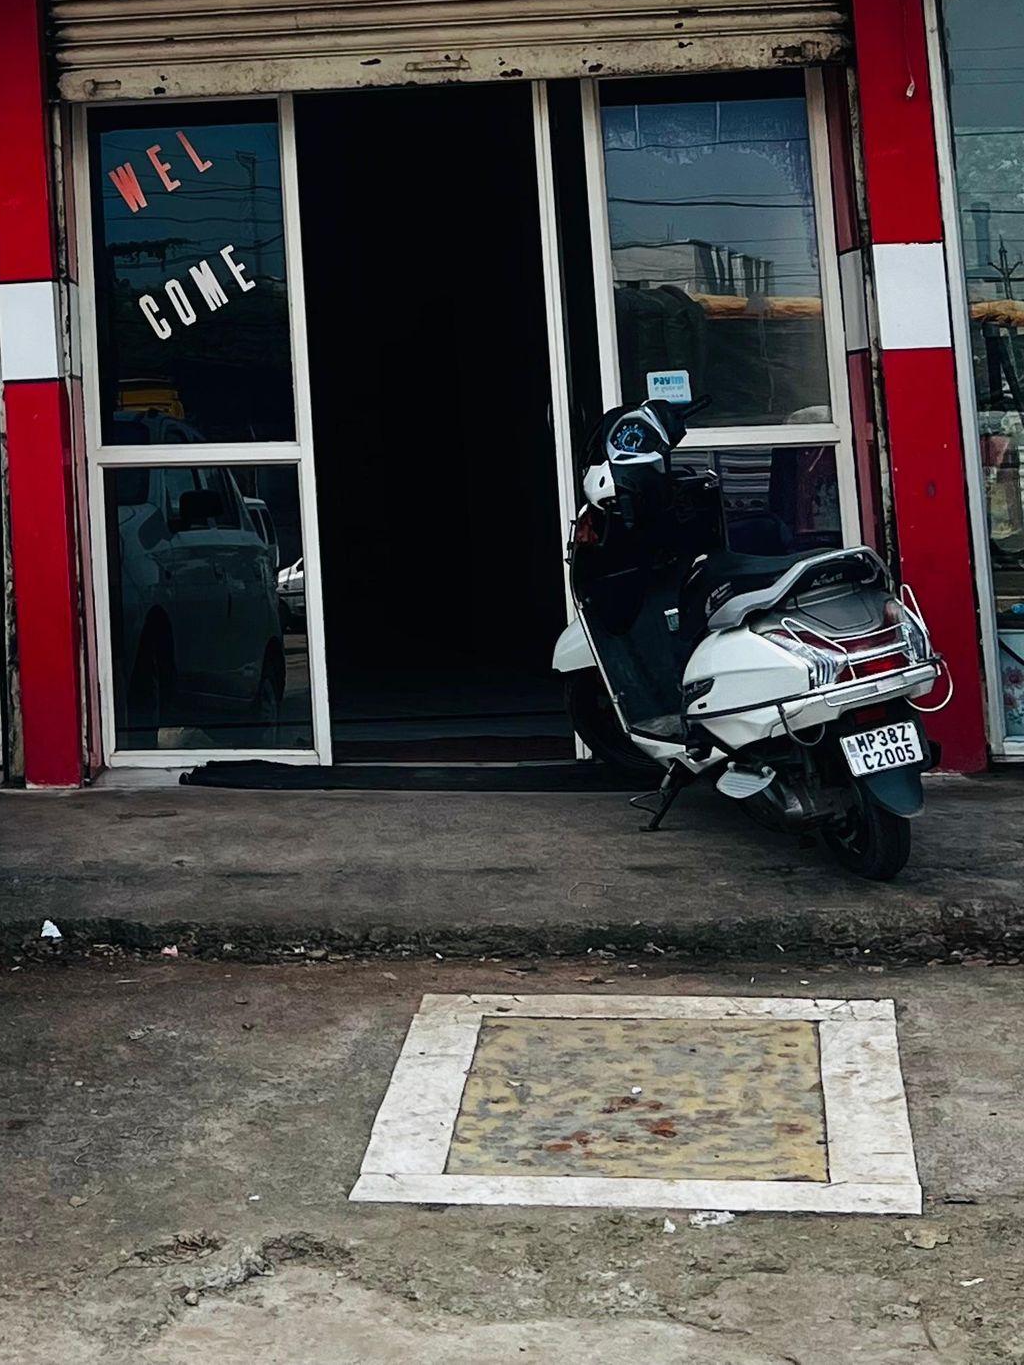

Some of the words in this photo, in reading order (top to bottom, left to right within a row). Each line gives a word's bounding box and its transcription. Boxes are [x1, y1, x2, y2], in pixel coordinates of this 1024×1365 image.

[108, 131, 213, 213] WEL
[139, 244, 256, 340] COME
[855, 725, 910, 752] MP38Z
[862, 743, 916, 770] C2005
